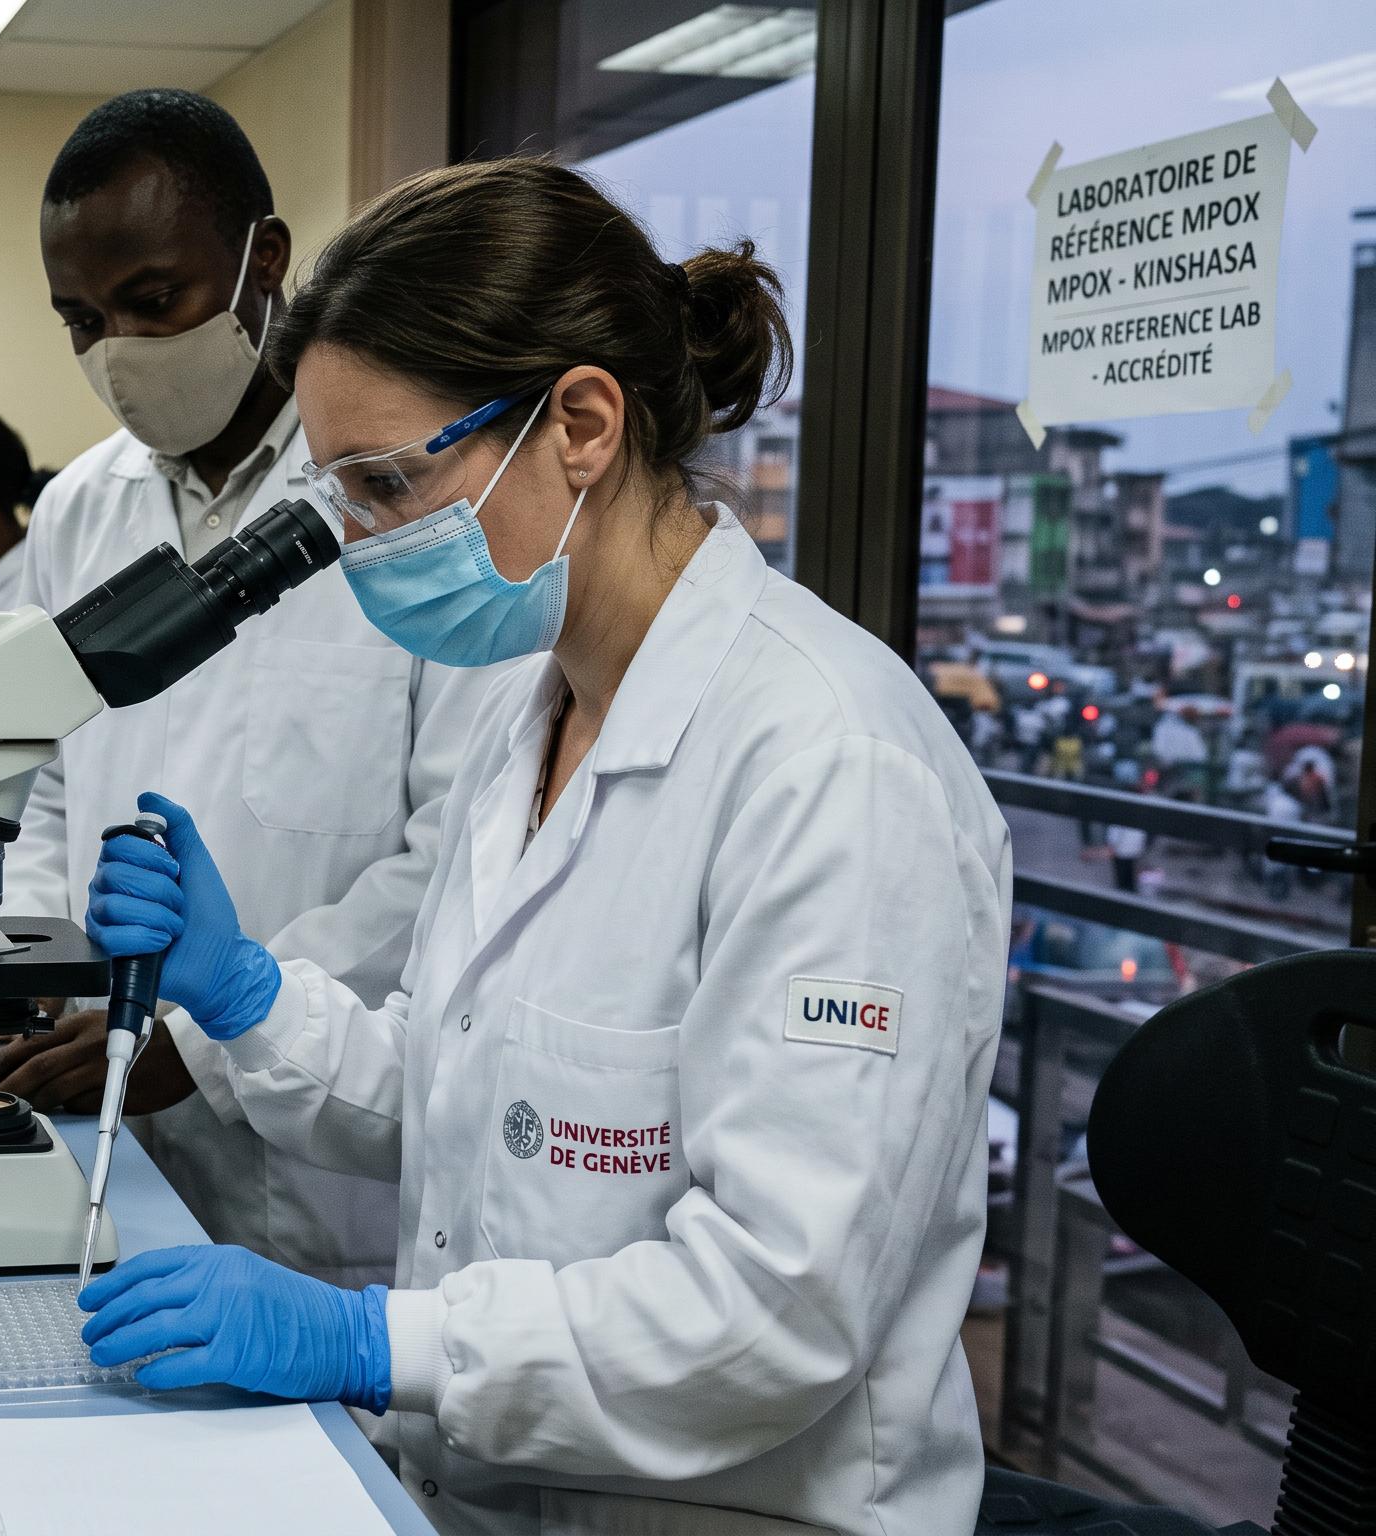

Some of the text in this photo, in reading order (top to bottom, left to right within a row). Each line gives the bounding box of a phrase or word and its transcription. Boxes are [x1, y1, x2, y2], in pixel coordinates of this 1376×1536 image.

[1058, 144, 1257, 217] LABORATOIRE DE
[1051, 192, 1260, 261] RÉFÉRENCE MPOX
[1048, 269, 1111, 305] MPOX
[1134, 241, 1257, 290] KINSHASA
[1042, 301, 1260, 354] MPOX REFERENCE LAB
[1104, 344, 1213, 385] ACCRÉDITÉ
[803, 997, 889, 1032] UNIGE
[550, 1117, 670, 1148] UNIVERSITÉ
[550, 1145, 670, 1174] DE GENÈVE
